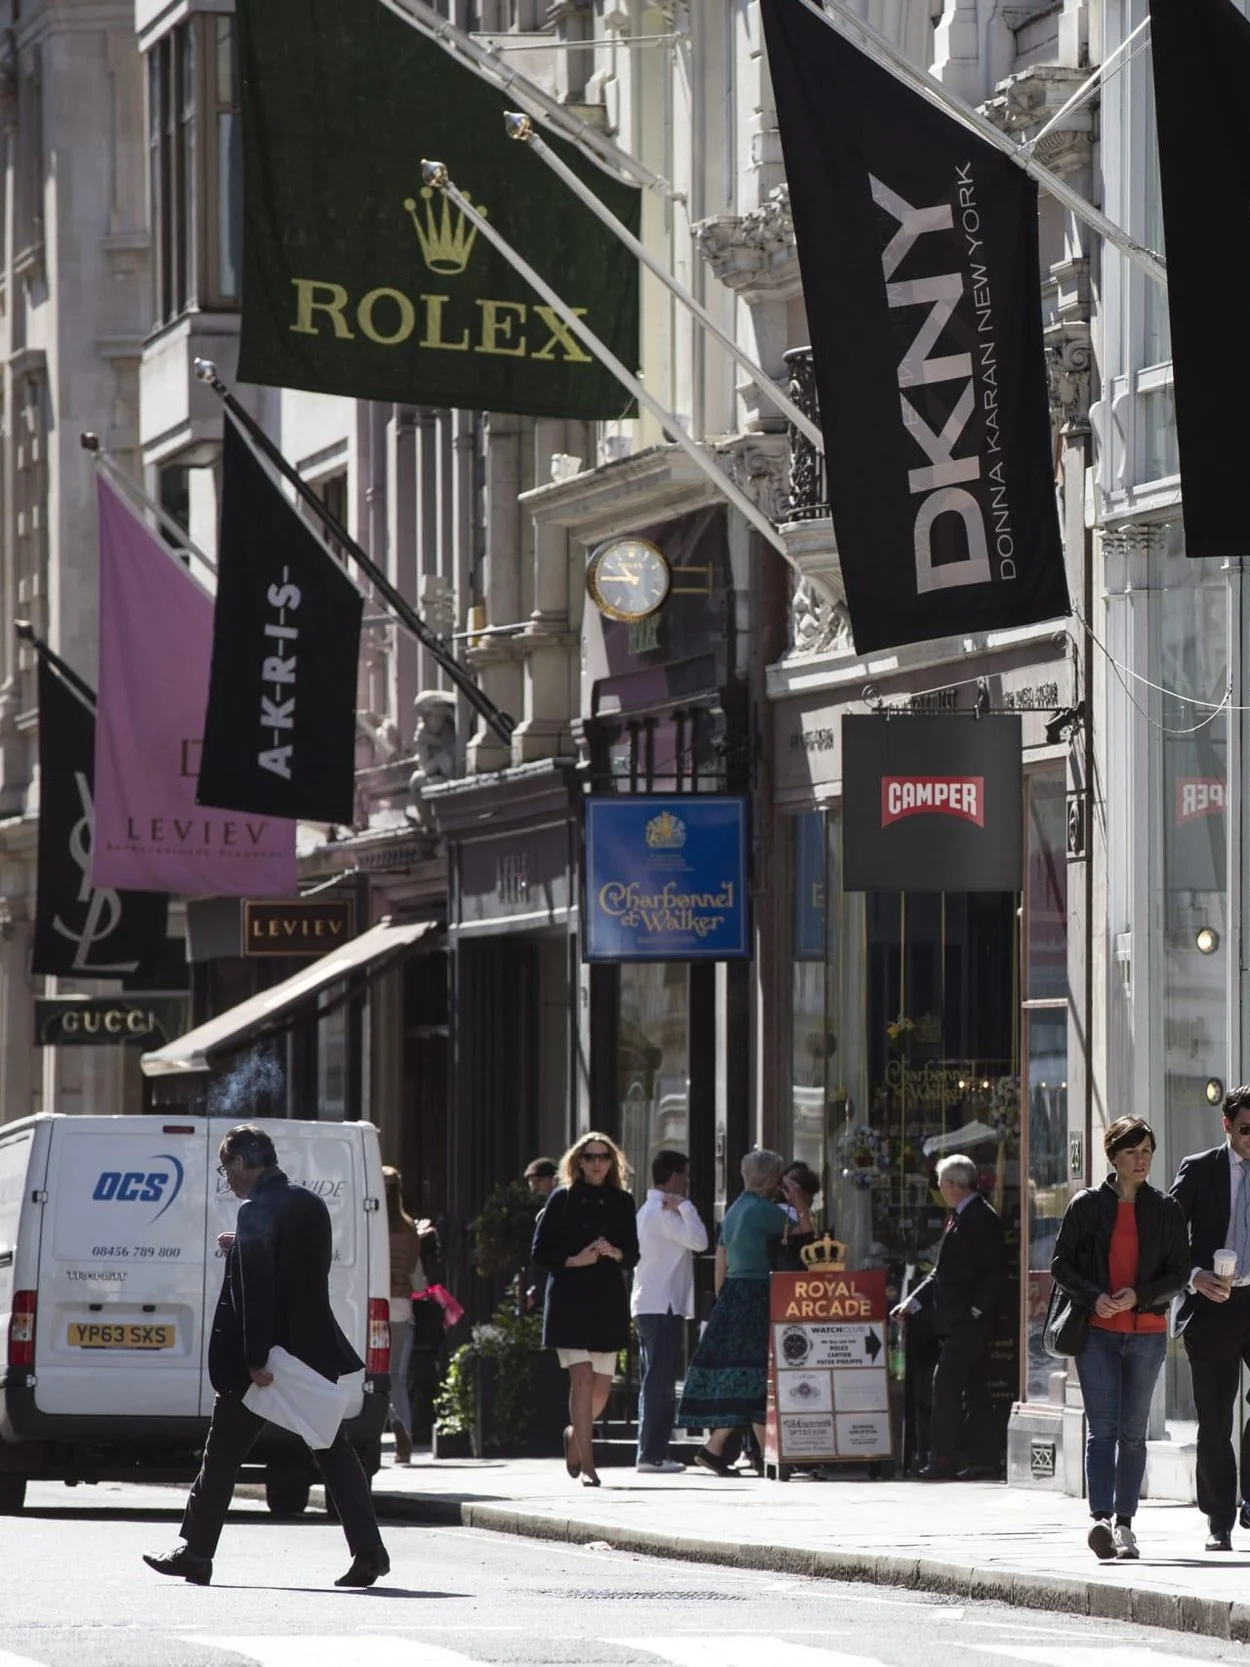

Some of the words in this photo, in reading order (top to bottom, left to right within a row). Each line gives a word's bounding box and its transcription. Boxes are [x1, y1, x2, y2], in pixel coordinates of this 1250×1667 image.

[955, 161, 983, 255] YORK
[970, 264, 993, 332] NEW
[289, 278, 593, 362] ROLEX
[868, 171, 992, 594] DKNY
[980, 344, 1001, 453] KARAN
[988, 462, 1016, 580] DONNA
[887, 782, 977, 816] CAMPER
[127, 816, 270, 845] LEVIEV
[599, 880, 734, 916] Charbonnel
[253, 919, 342, 937] LEVIEV
[639, 909, 726, 937] Walker
[62, 1010, 154, 1032] GUCCI
[92, 1171, 169, 1201] OCS
[92, 1246, 129, 1258] 08456
[134, 1246, 155, 1258] 789
[158, 1247, 181, 1258] 800
[794, 1281, 861, 1298] ROYAL
[785, 1299, 872, 1317] ARCADE
[76, 1324, 125, 1344] YP63
[130, 1324, 167, 1344] SXS
